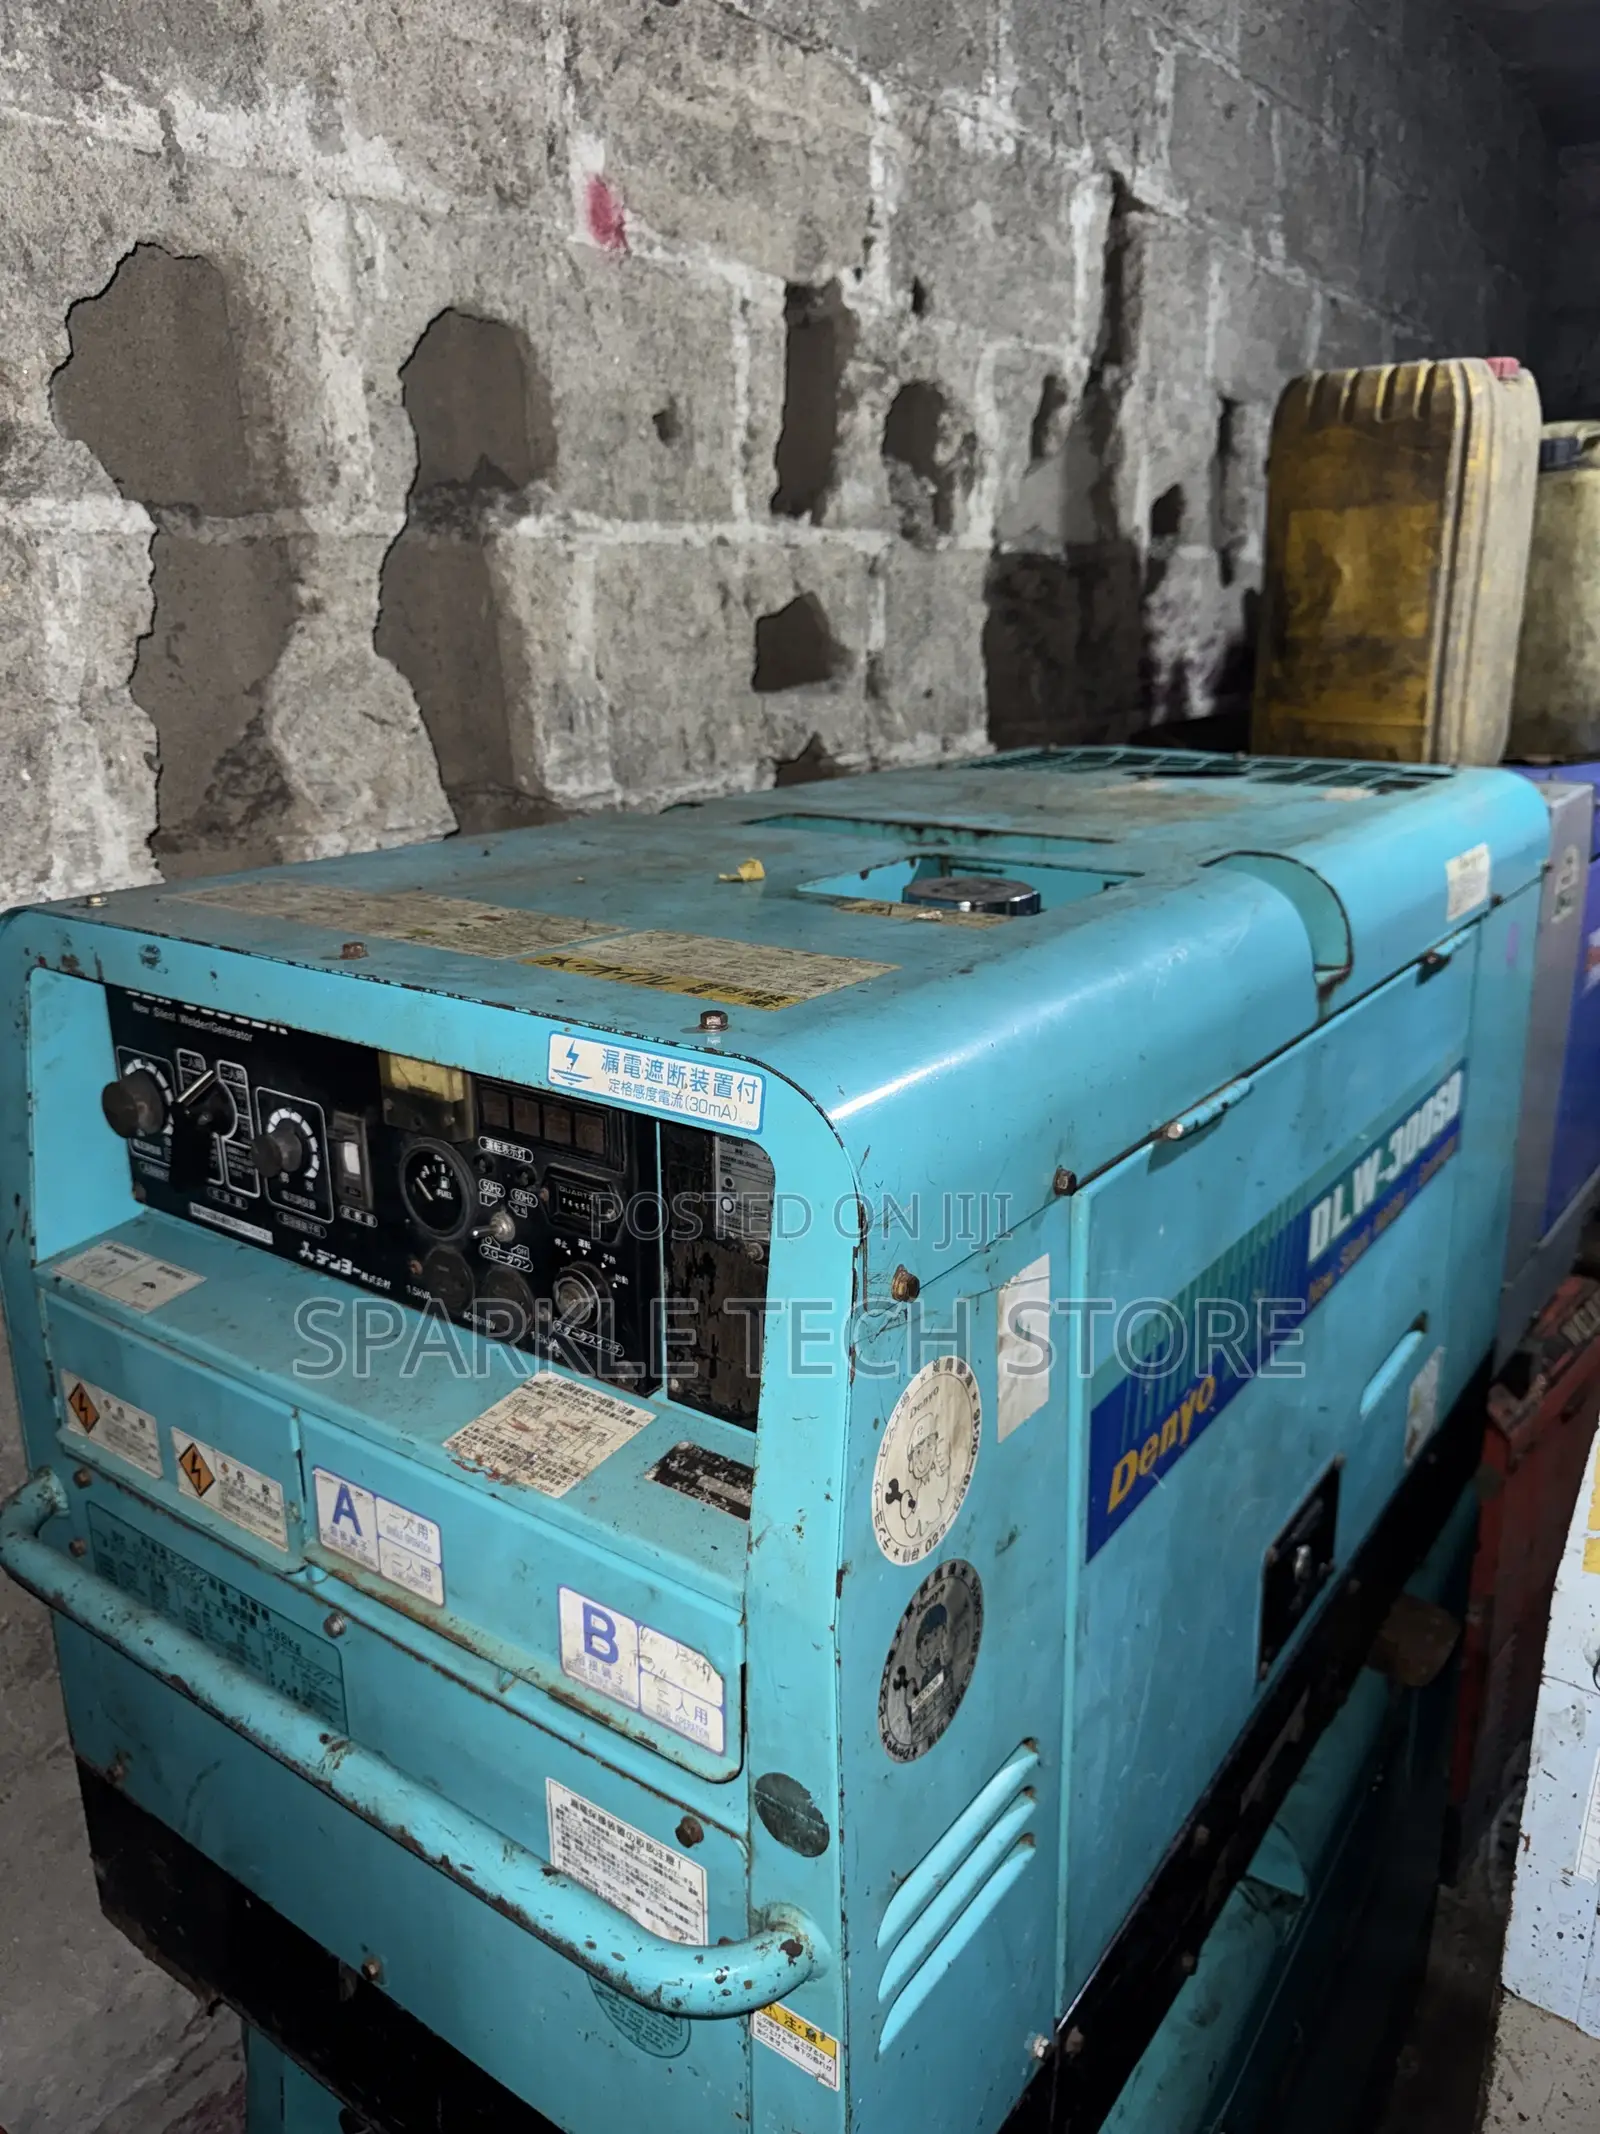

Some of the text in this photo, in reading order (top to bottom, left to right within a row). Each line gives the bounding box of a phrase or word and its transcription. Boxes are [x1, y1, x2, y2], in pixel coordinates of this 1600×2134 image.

[601, 1048, 758, 1105] 漏電遮断装置付
[608, 1078, 738, 1121] 定格感度電流(30mA)
[436, 1188, 454, 1200] FUEL
[483, 1181, 501, 1195] 50Hz
[514, 1190, 534, 1206] 60Hz
[909, 1385, 940, 1420] Denyo
[1107, 1375, 1216, 1515] Denyo
[332, 1482, 363, 1537] A
[391, 1553, 432, 1583] 二人用
[582, 1602, 620, 1665] B
